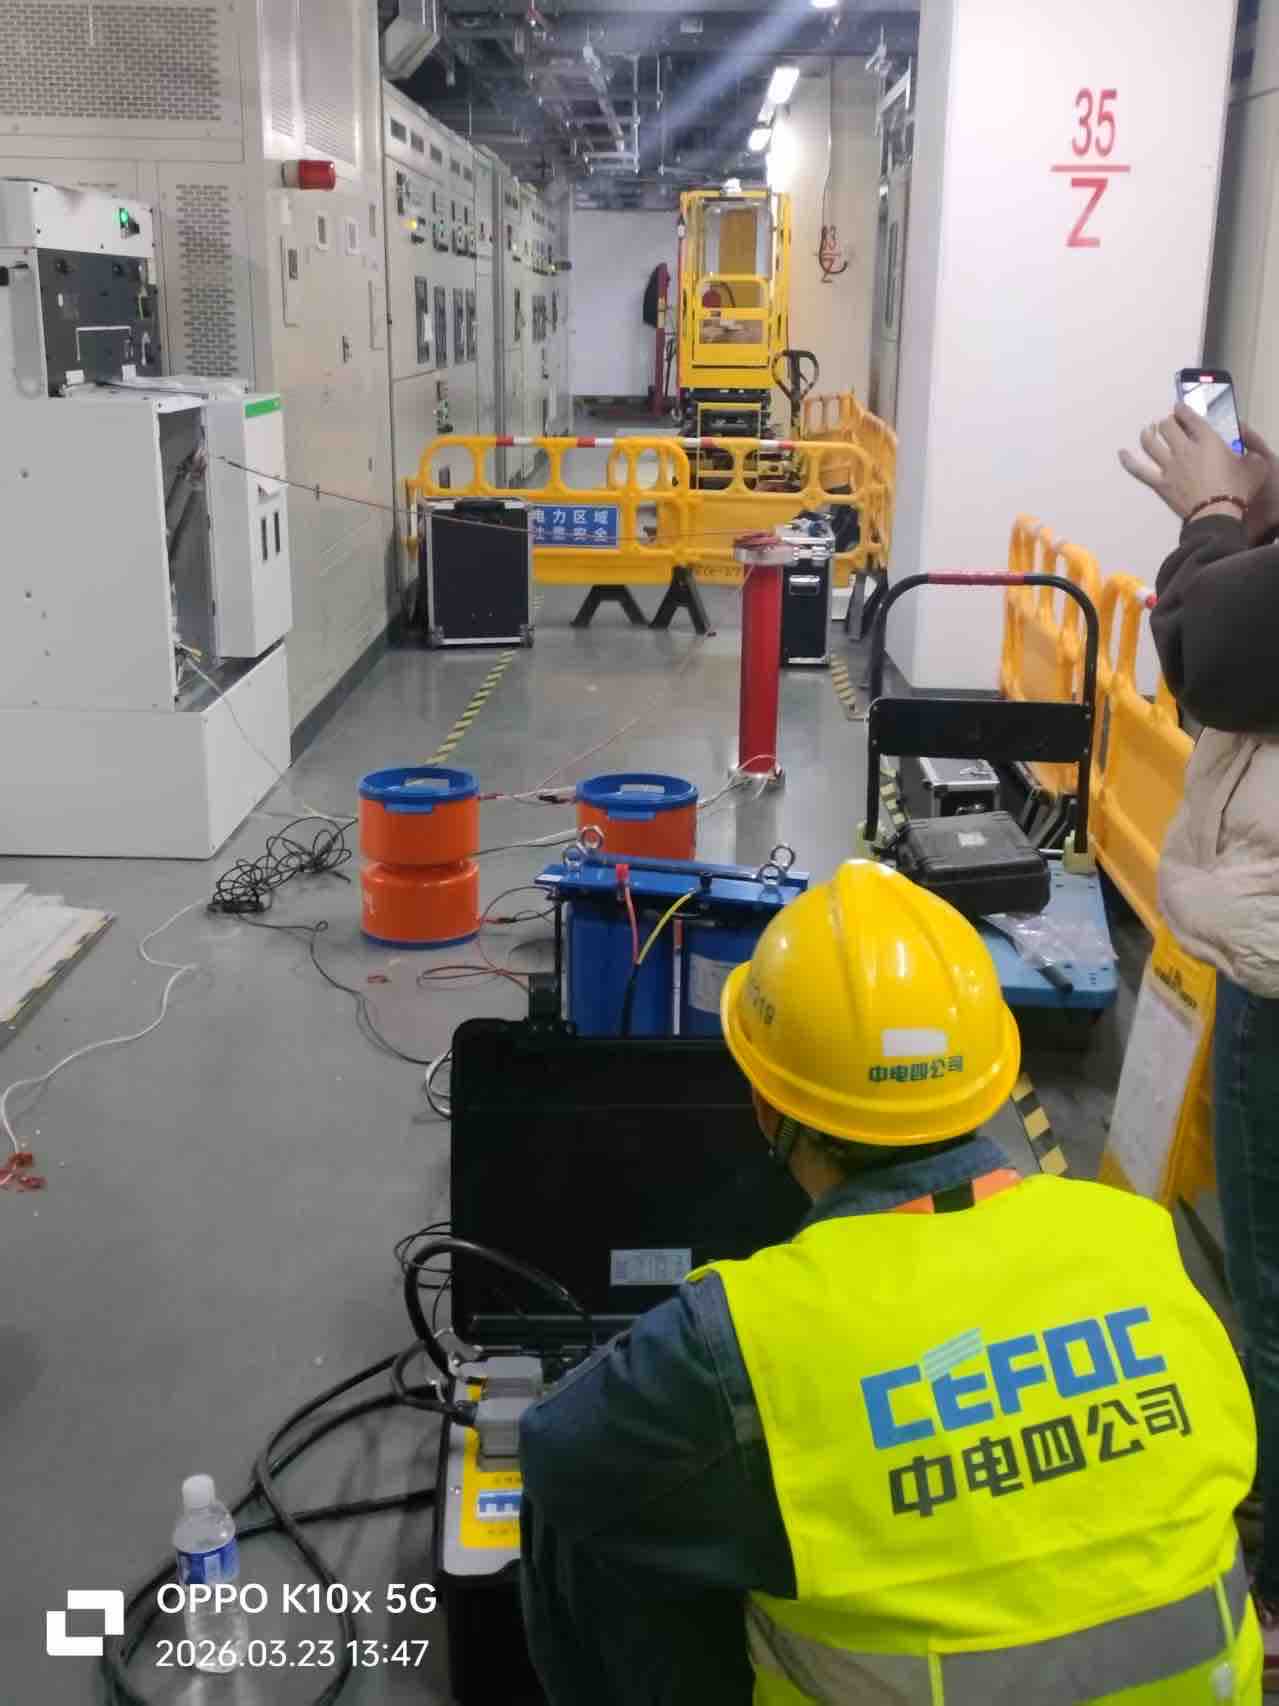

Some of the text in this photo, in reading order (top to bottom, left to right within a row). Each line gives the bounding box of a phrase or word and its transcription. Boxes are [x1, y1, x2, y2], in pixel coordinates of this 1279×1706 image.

[1071, 87, 1118, 157] 35
[1066, 178, 1108, 248] Z
[868, 1056, 963, 1083] 中电四公司
[859, 1305, 1167, 1450] CEFOC
[888, 1383, 1193, 1518] 中电四公司
